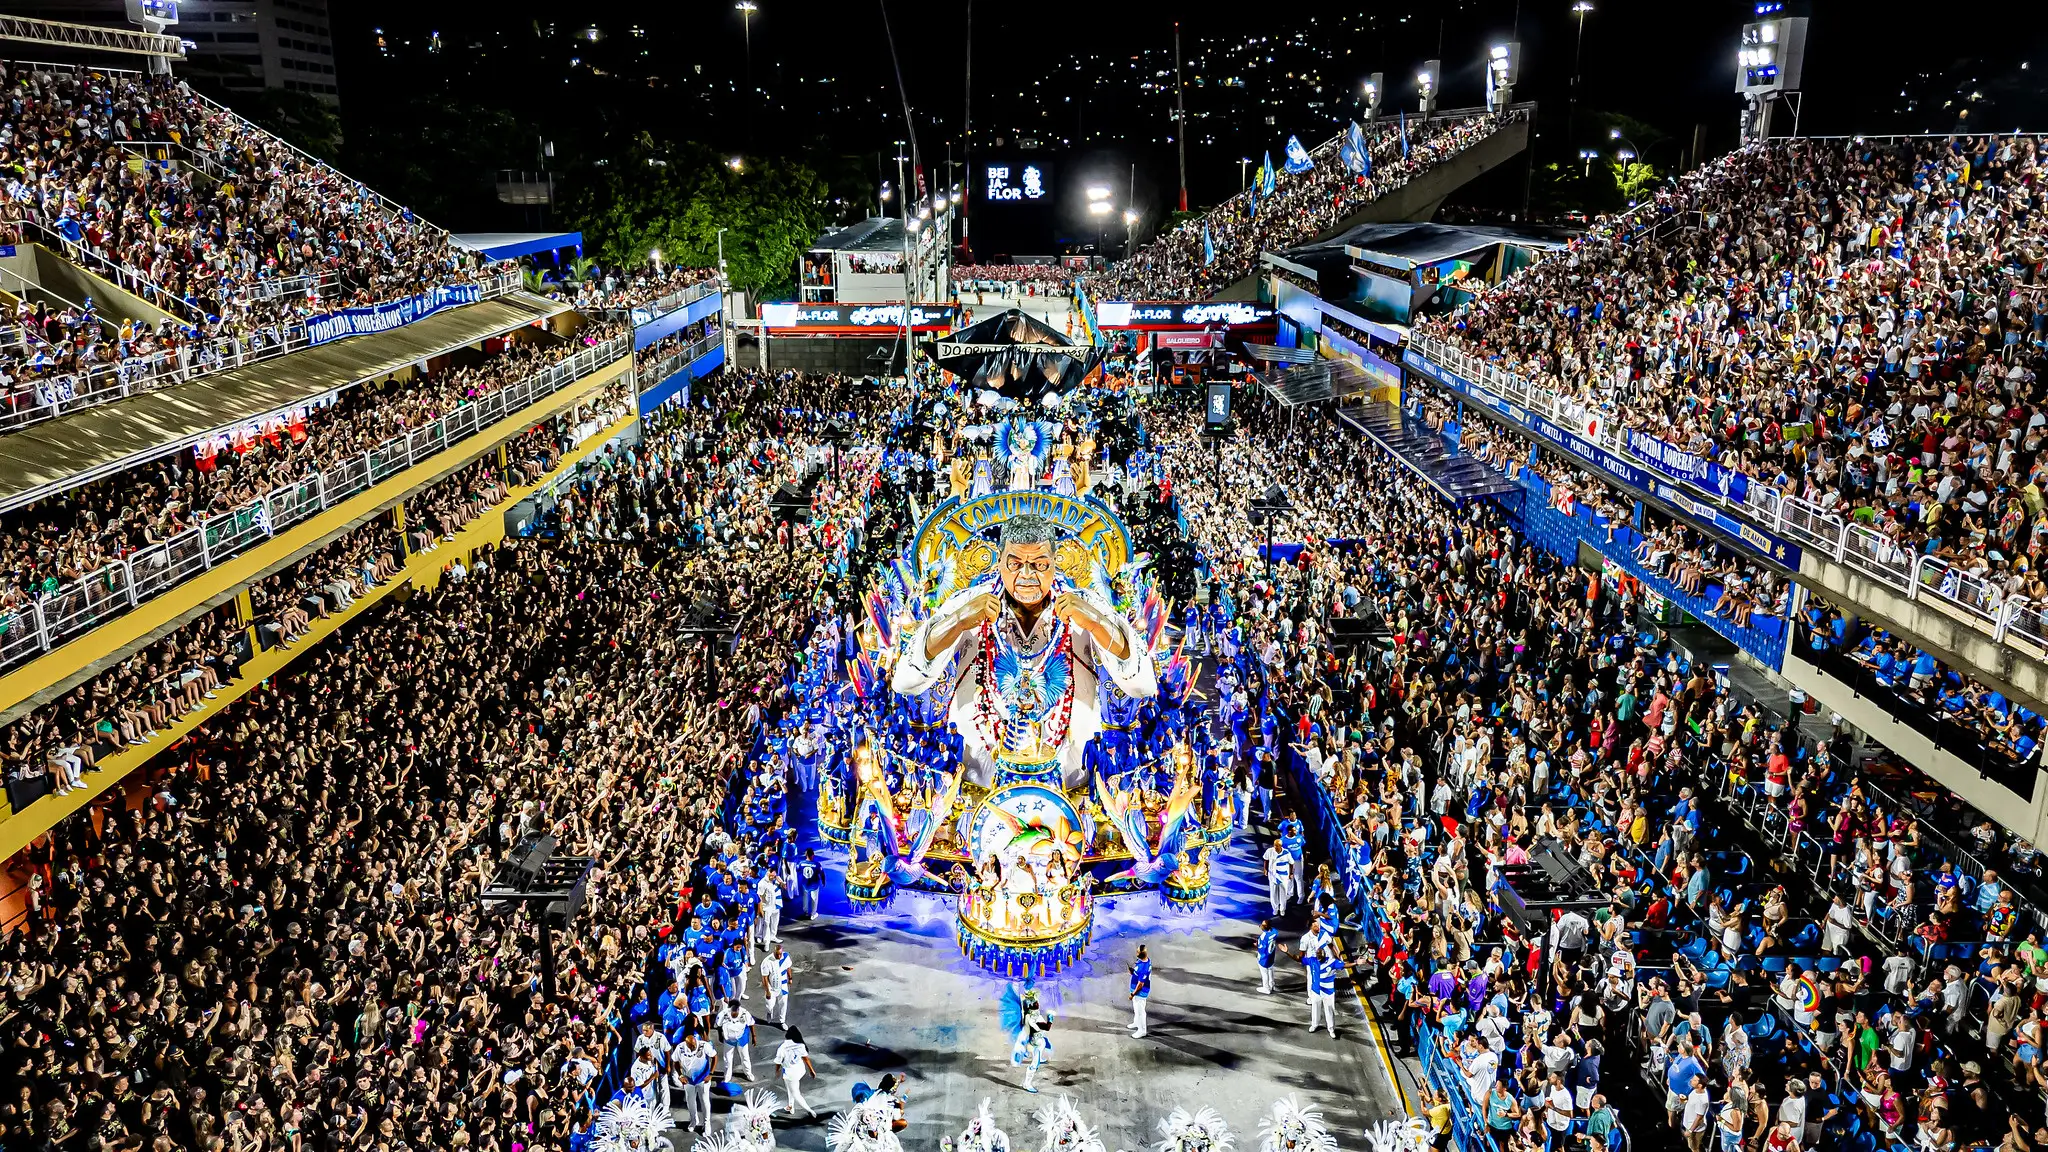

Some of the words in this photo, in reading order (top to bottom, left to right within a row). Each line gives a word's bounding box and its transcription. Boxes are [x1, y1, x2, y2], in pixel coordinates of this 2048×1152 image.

[988, 167, 1009, 179] BEI
[988, 178, 1008, 189] JA-
[988, 188, 1022, 200] FLOR
[308, 314, 353, 344] TORCIDA
[352, 308, 403, 333] SOBERANOS
[942, 345, 962, 357] DO
[1541, 422, 1563, 444] PORTELA
[1570, 438, 1595, 461] PORTELA
[1603, 456, 1631, 482] PORTELA
[1663, 445, 1709, 480] SOBERAS
[958, 496, 1093, 533] COMUNIDADE
[1695, 504, 1702, 514] NA
[1703, 507, 1714, 519] VIDA
[1743, 527, 1750, 538] DE
[1751, 533, 1766, 549] AMAR
